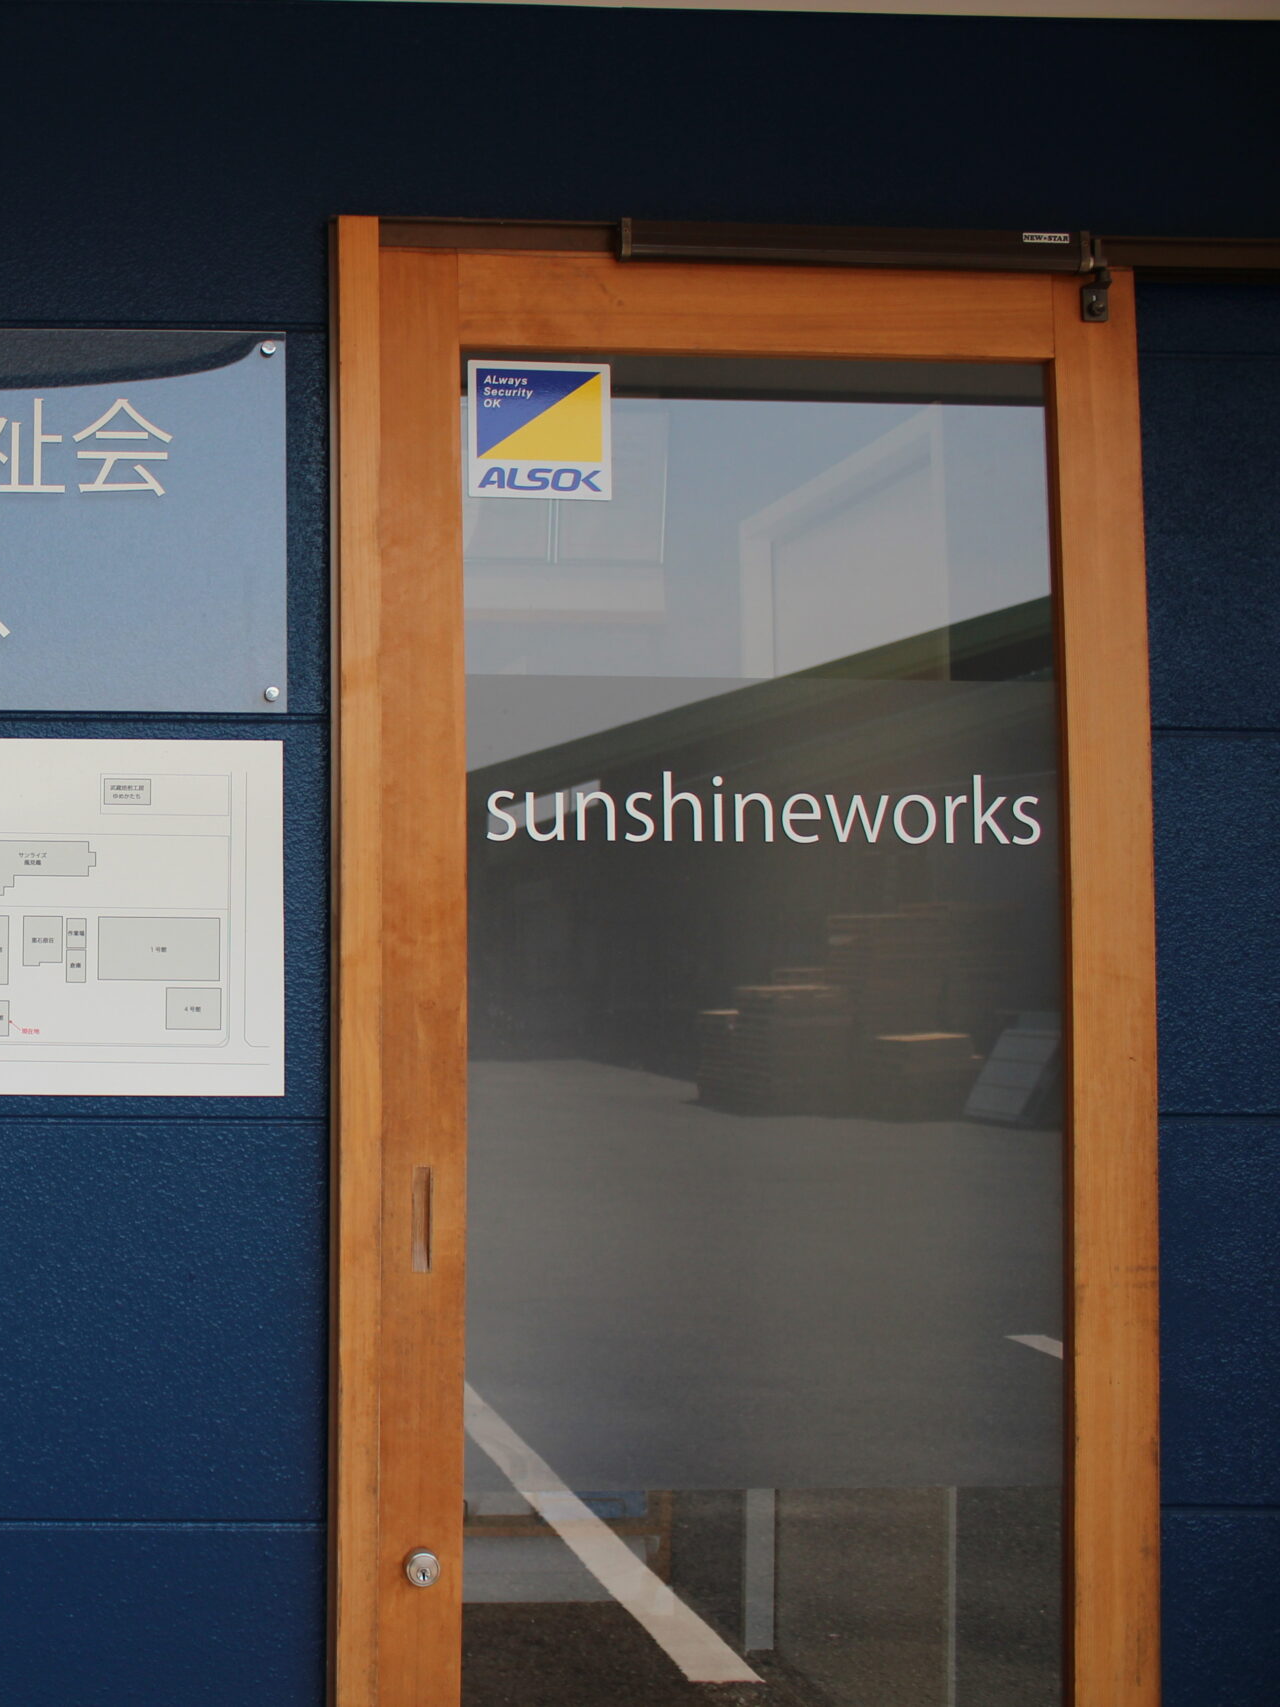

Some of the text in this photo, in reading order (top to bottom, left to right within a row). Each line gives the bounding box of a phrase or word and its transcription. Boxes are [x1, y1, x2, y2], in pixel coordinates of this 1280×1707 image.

[483, 375, 528, 386] ALways
[483, 387, 533, 399] Security
[483, 398, 501, 408] OK
[477, 466, 602, 492] ALSOK
[486, 771, 1042, 845] sunshineworks
